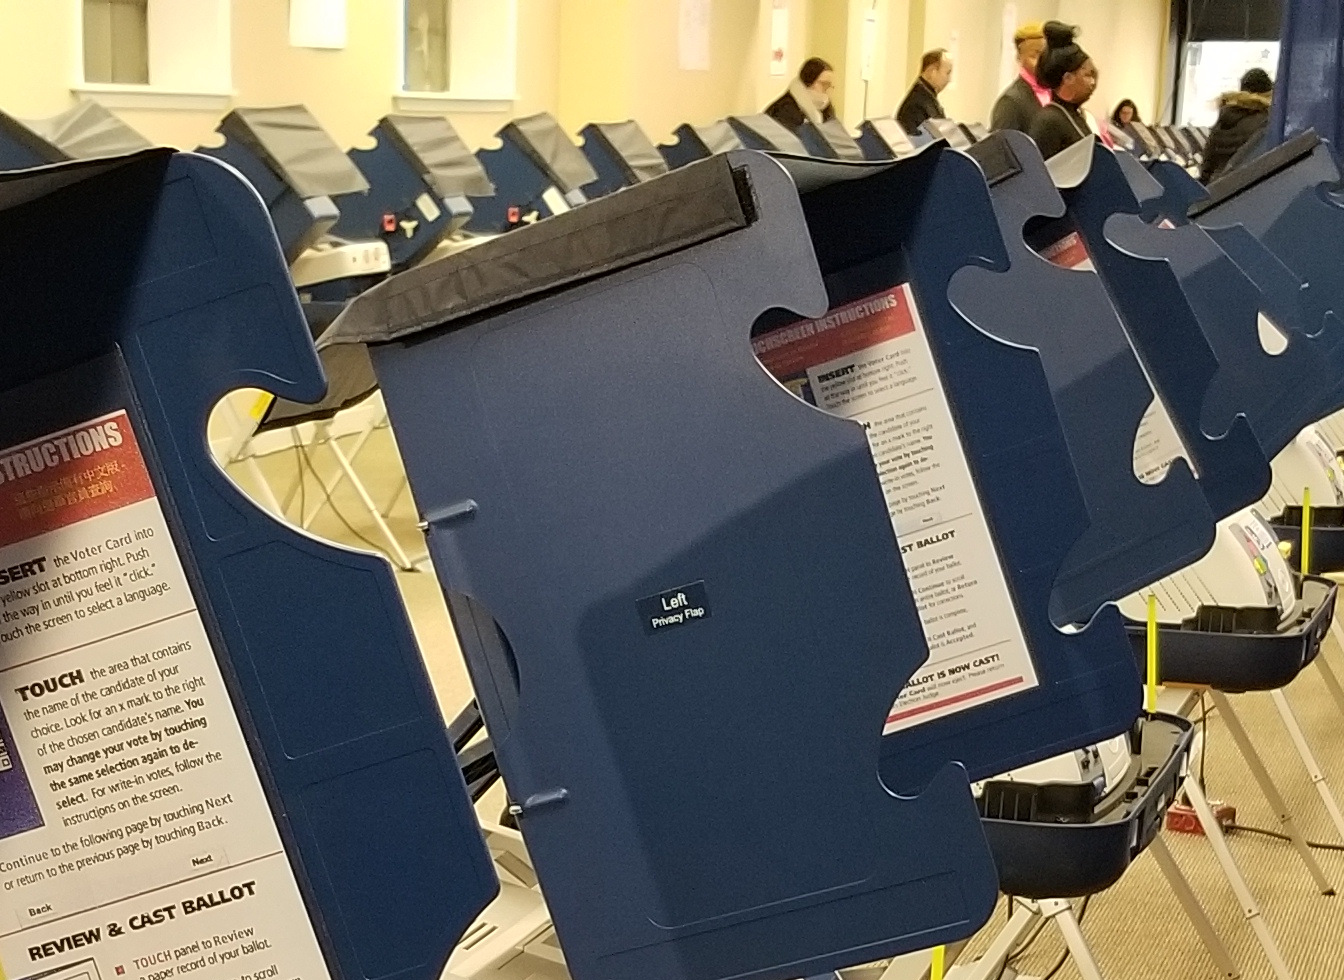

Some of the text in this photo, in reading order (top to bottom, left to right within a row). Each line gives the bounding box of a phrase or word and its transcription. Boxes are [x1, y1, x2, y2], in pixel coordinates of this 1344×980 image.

[814, 293, 898, 333] INSTRUCTIONS
[816, 363, 856, 384] INSERT
[52, 555, 71, 569] the
[69, 544, 102, 562] Voter
[105, 532, 133, 551] Card
[134, 527, 154, 541] into
[915, 529, 956, 549] BALLOT
[24, 622, 42, 635] the
[42, 613, 74, 630] screen
[73, 609, 86, 620] to
[86, 598, 116, 616] select
[116, 596, 124, 606] a
[122, 582, 171, 603] language.
[651, 606, 705, 629] Privacy Flap
[661, 592, 688, 611] Left
[14, 640, 192, 702] TOUCH the area that contains
[902, 653, 1000, 689] ALLOT IS NOW CAST!
[42, 716, 208, 775] may change your vote by touching
[49, 847, 62, 858] to
[61, 841, 80, 854] the
[79, 827, 125, 848] following
[124, 820, 150, 838] page
[148, 815, 162, 828] by
[162, 803, 205, 823] touching
[204, 793, 234, 810] Next
[191, 854, 214, 867] Next
[27, 880, 256, 962] REVIEW & CAST BALLOT
[28, 903, 53, 917] Back
[132, 927, 254, 970] TOUCH panel to Review
[176, 955, 207, 975] record
[207, 951, 219, 965] of
[218, 947, 240, 965] your
[240, 939, 272, 955] ballot.
